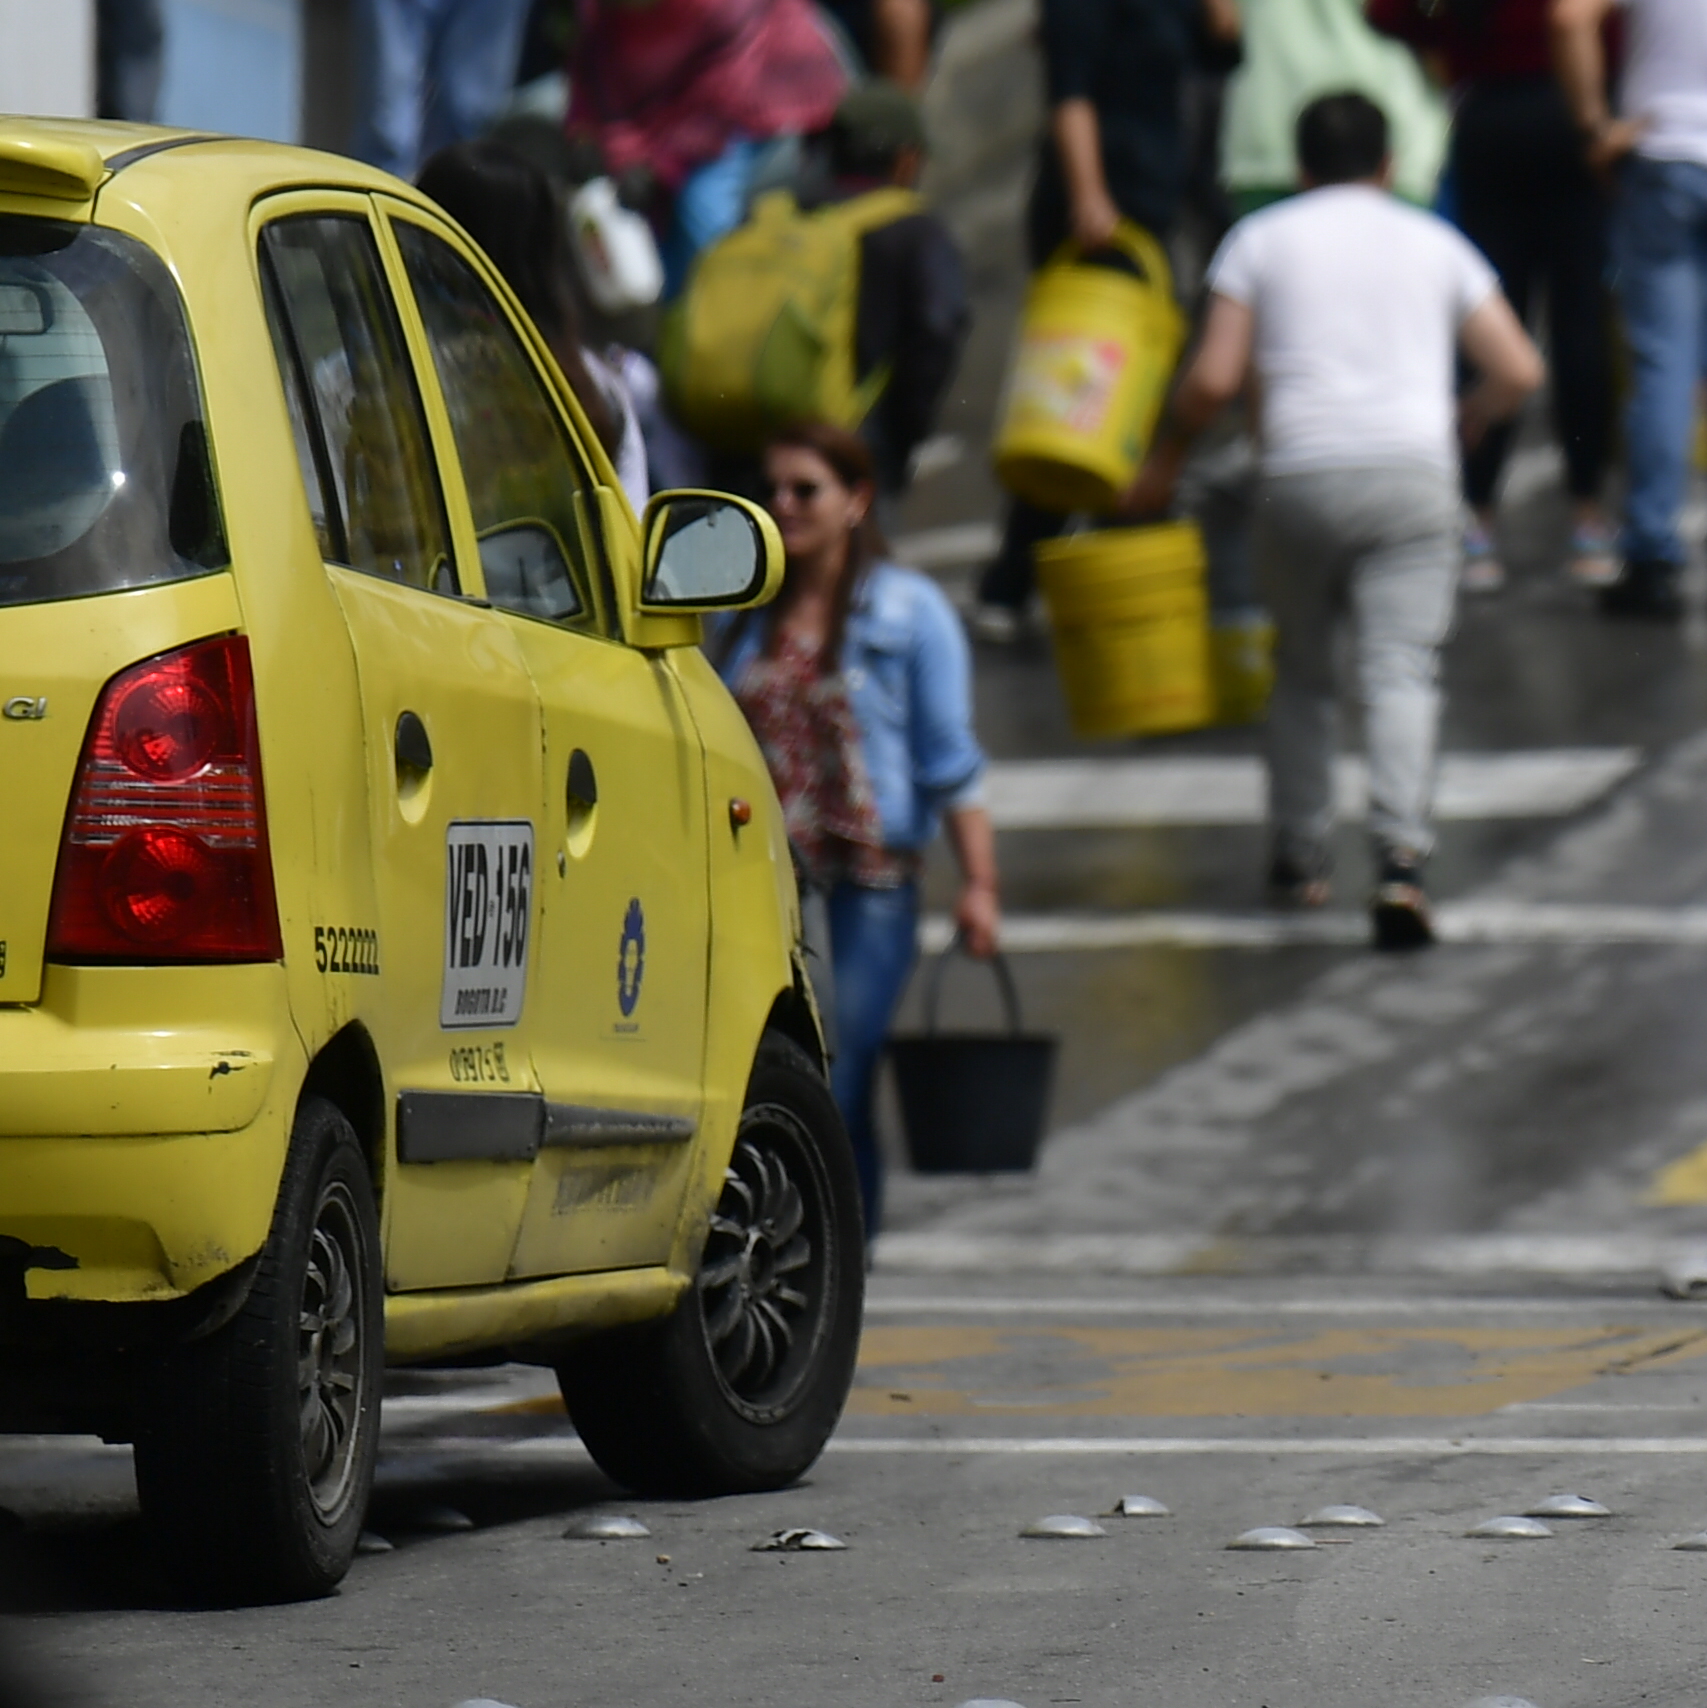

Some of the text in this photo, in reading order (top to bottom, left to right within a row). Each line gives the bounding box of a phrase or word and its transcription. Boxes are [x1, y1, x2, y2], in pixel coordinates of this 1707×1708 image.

[449, 841, 531, 969] VED 156
[314, 925, 380, 976] 5222222
